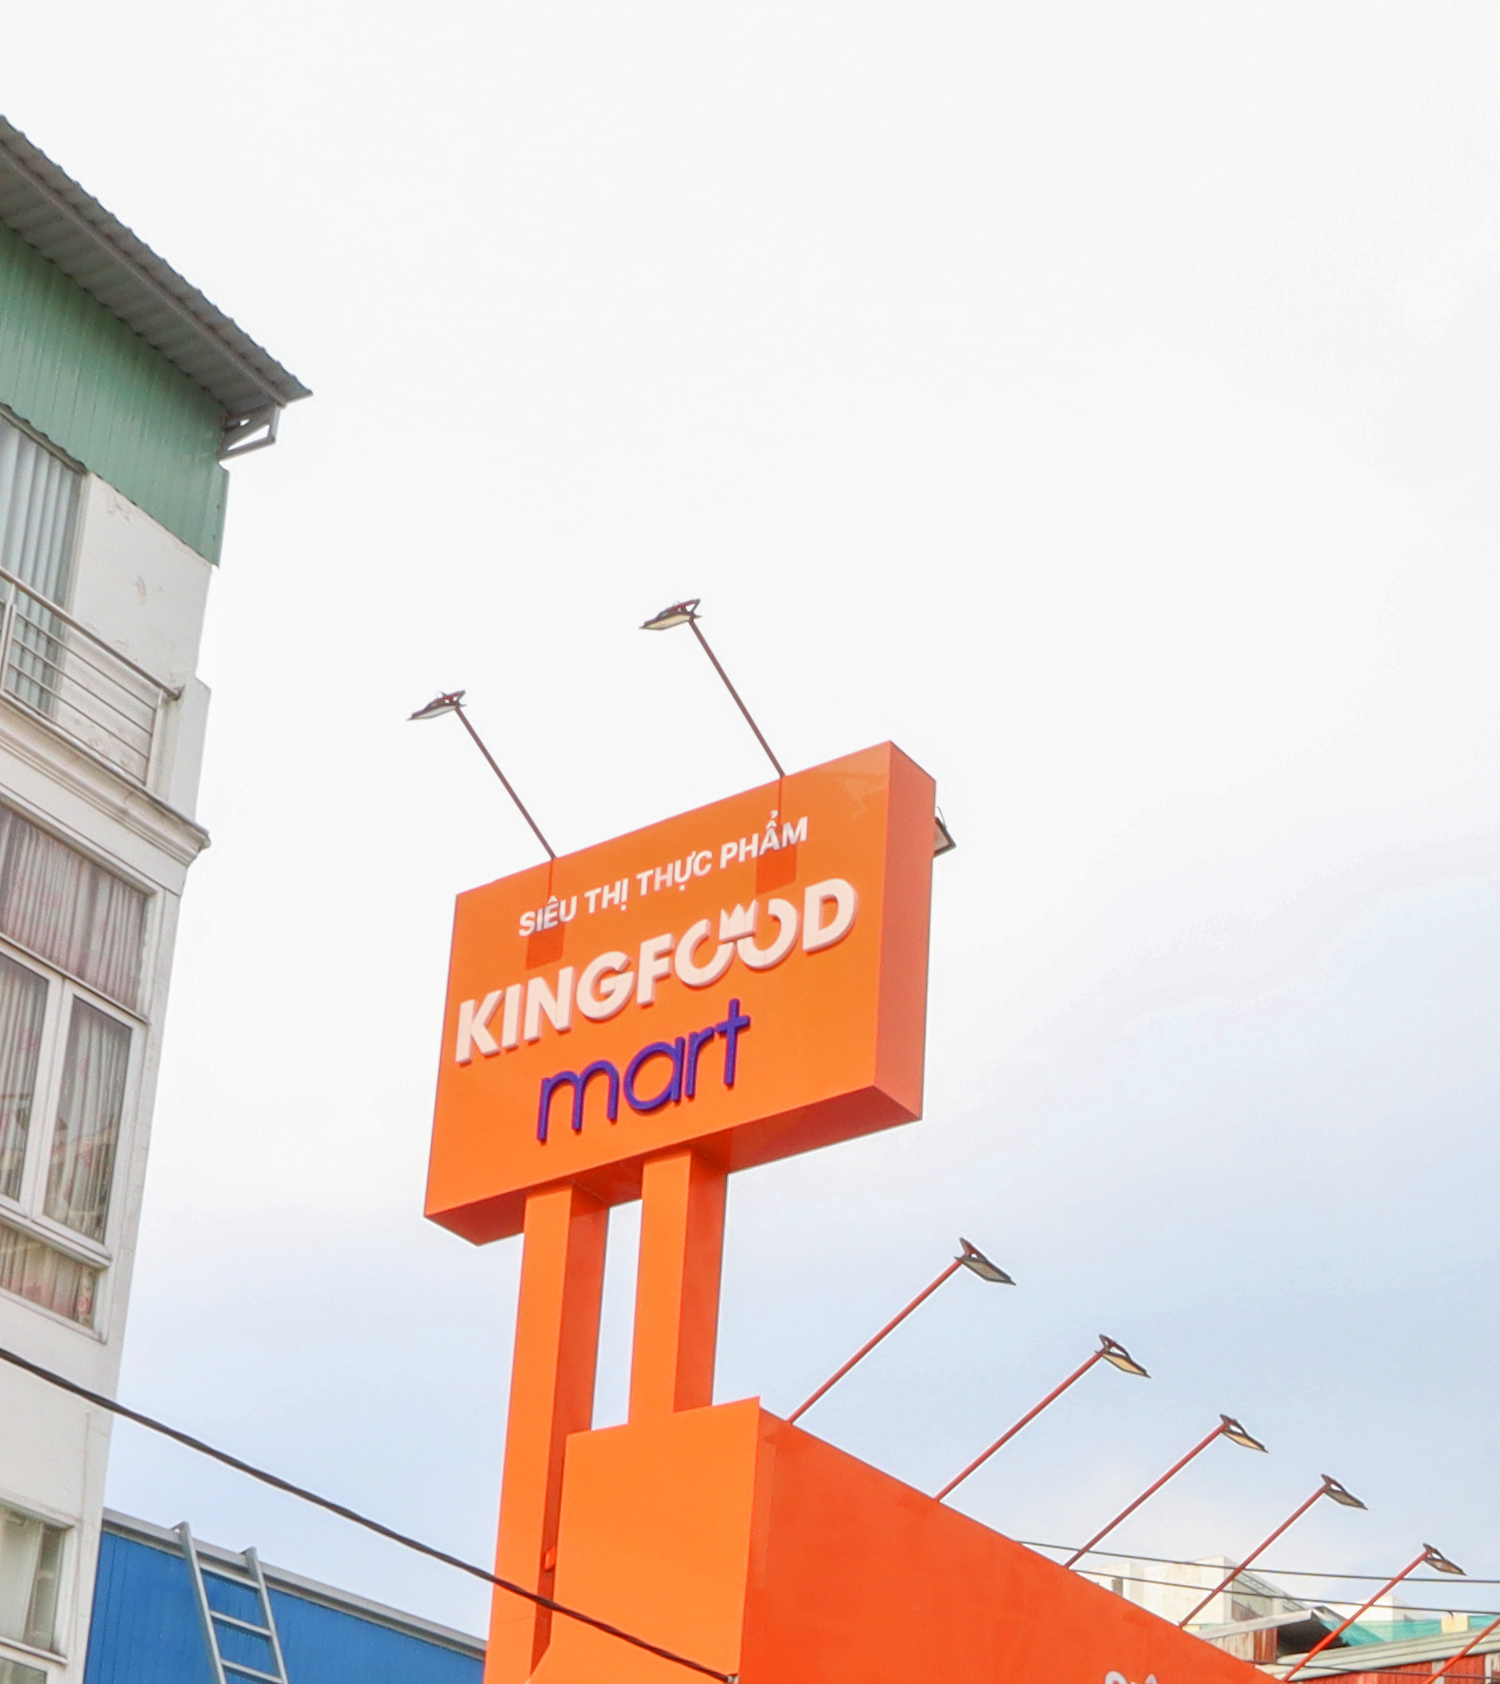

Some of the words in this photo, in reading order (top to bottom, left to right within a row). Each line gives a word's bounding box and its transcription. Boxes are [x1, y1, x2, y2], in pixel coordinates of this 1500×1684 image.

[518, 896, 577, 937] SIÊU
[584, 878, 629, 912] THỊ
[637, 849, 713, 892] THỰC
[720, 810, 809, 870] PHẨM
[455, 877, 859, 1065] KINGFOOD
[536, 998, 751, 1143] mart
